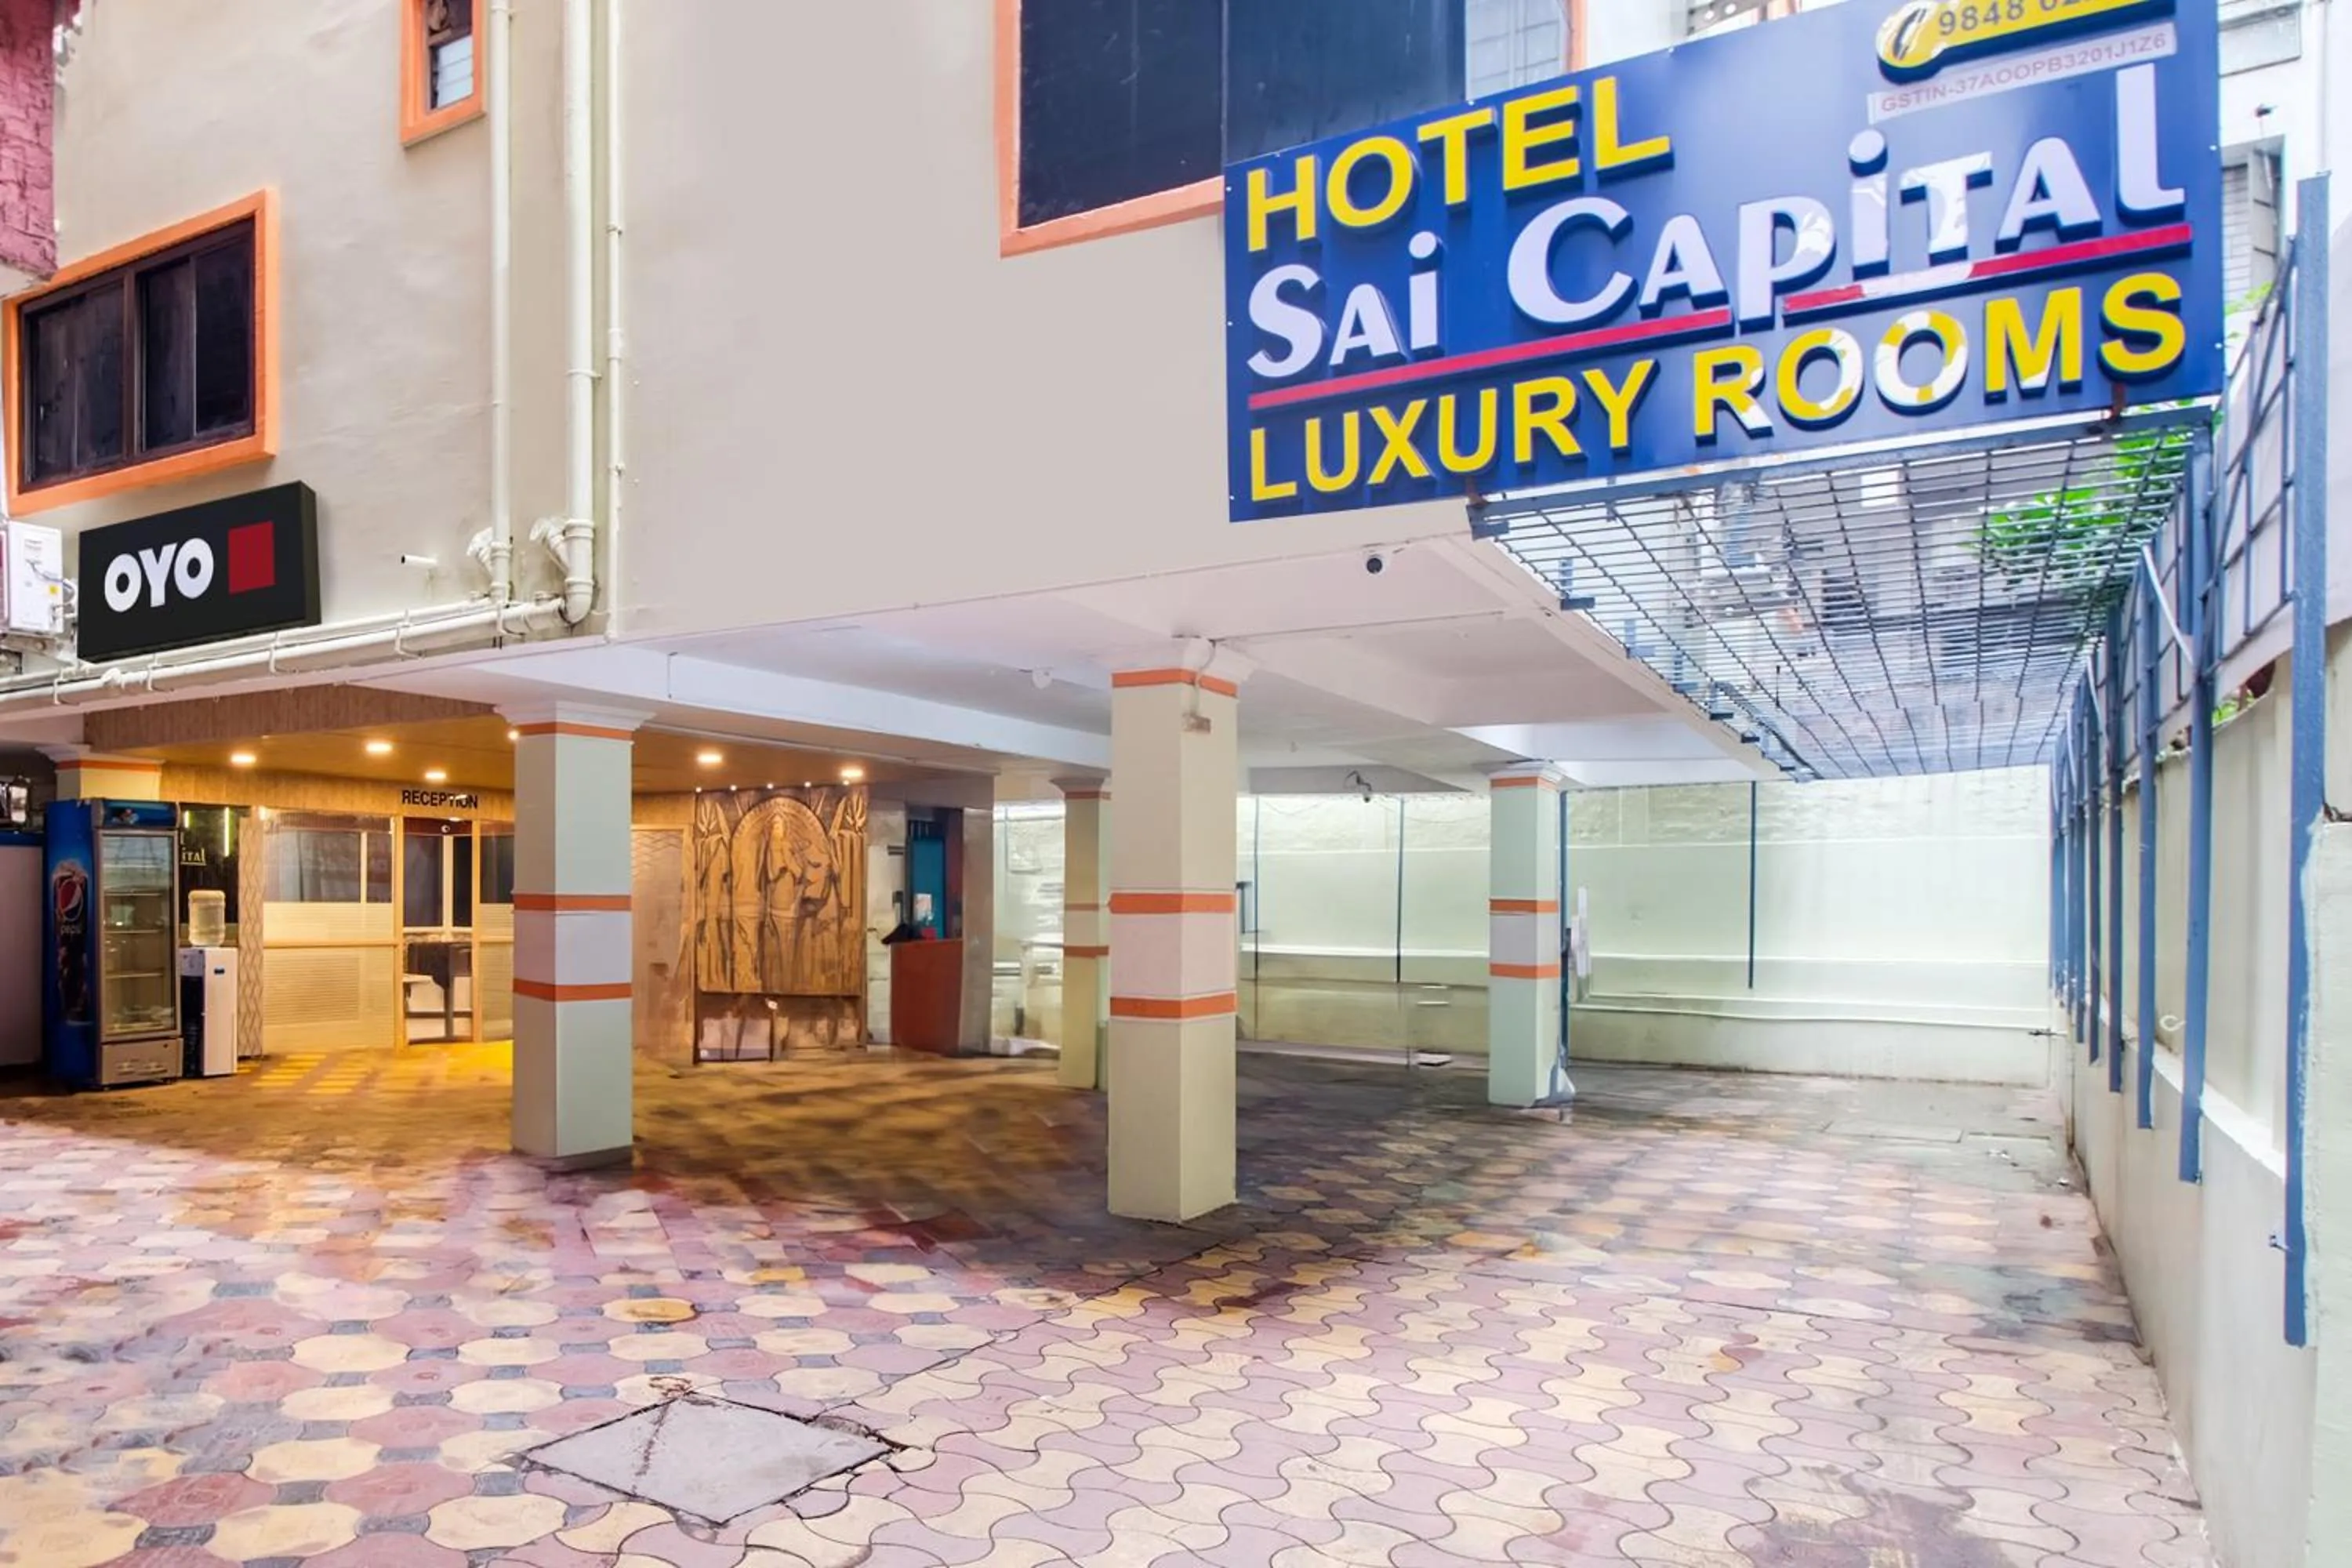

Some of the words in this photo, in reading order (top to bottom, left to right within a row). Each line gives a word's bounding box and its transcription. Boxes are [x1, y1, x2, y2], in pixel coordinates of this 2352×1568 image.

[1939, 0, 2025, 36] 9848
[1247, 76, 1672, 252] HOTEL
[1250, 359, 1657, 502] LUXURY
[1693, 272, 2187, 437] ROOMS
[104, 538, 214, 613] OYO
[401, 789, 478, 809] RECEPTION
